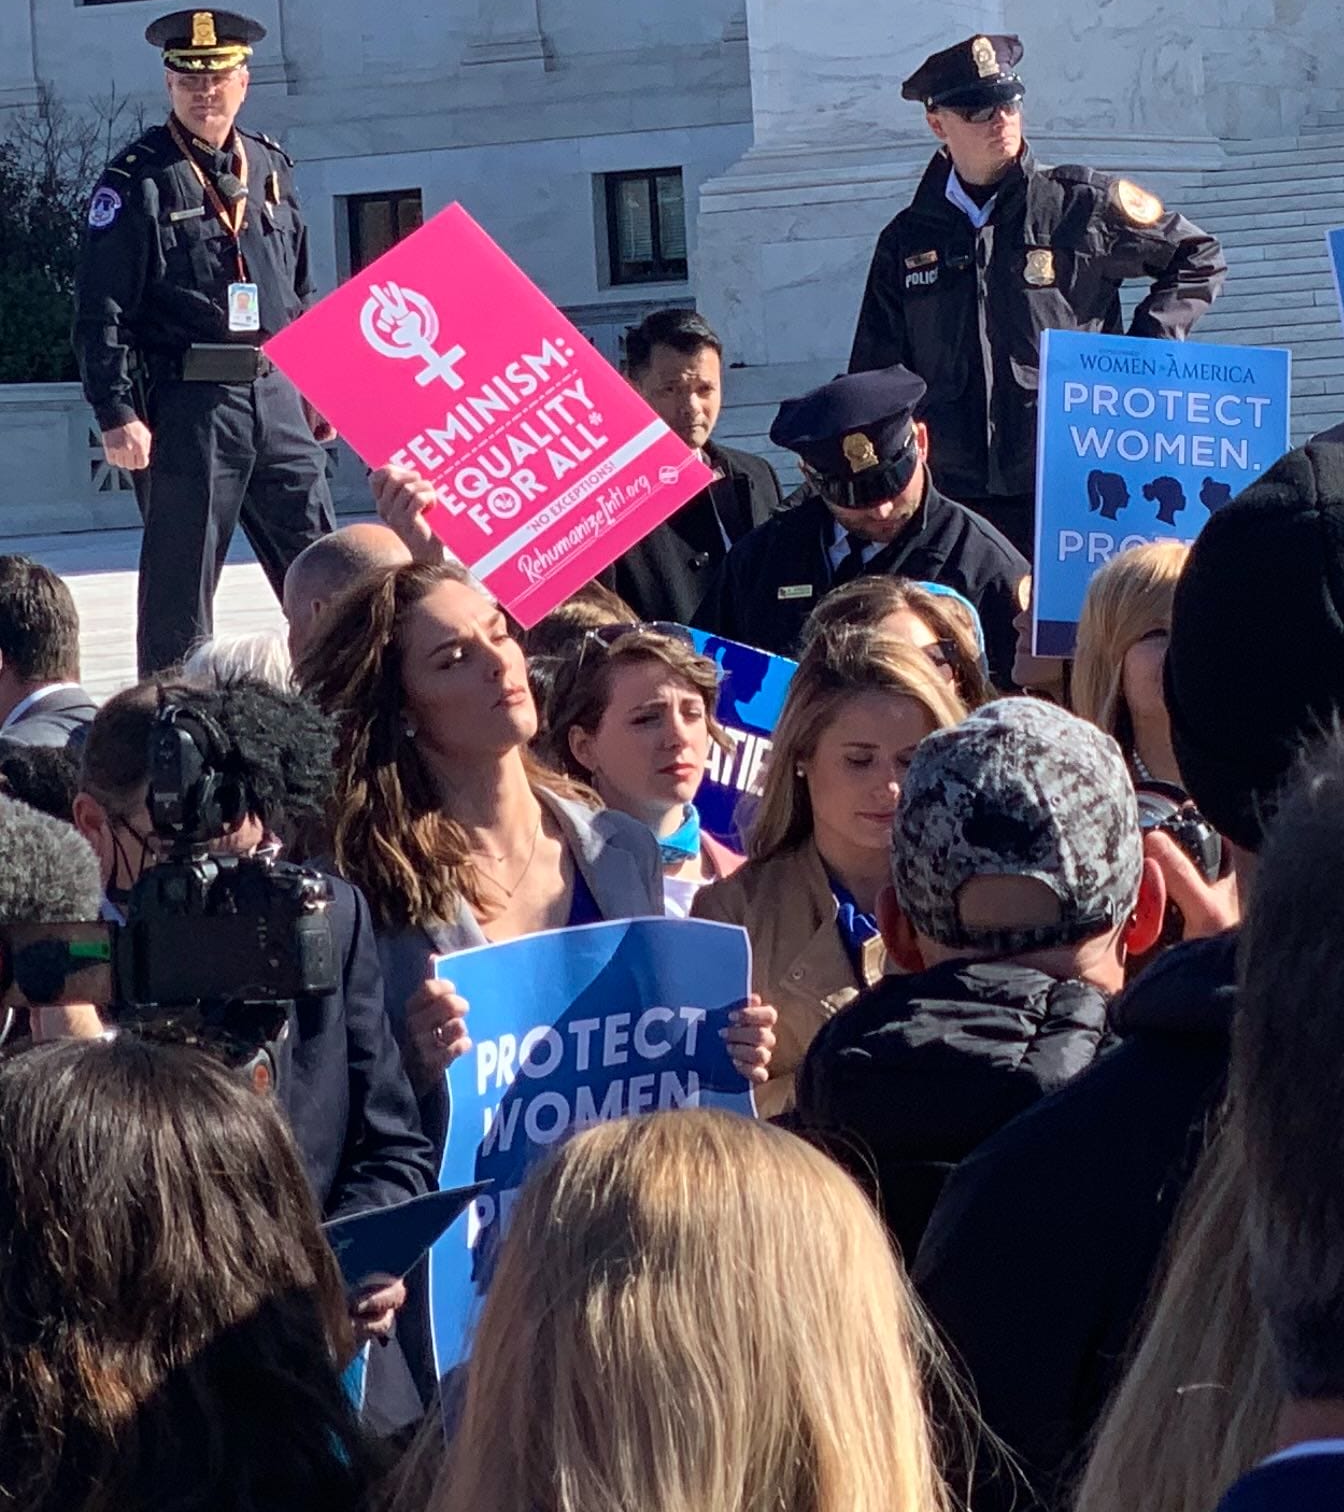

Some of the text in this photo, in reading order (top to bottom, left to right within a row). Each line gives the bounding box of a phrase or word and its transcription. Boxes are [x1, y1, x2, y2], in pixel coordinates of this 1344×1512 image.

[1080, 353, 1256, 384] WOMEN AMERICA
[389, 337, 575, 471] FEMINISM:
[1063, 381, 1272, 428] PROTECT
[436, 377, 595, 516] EQUALITY
[1069, 425, 1262, 472] WOMEN.
[466, 468, 548, 536] FOR
[550, 460, 617, 518] EXCEPTIONS!
[476, 1006, 707, 1096] PROTECT
